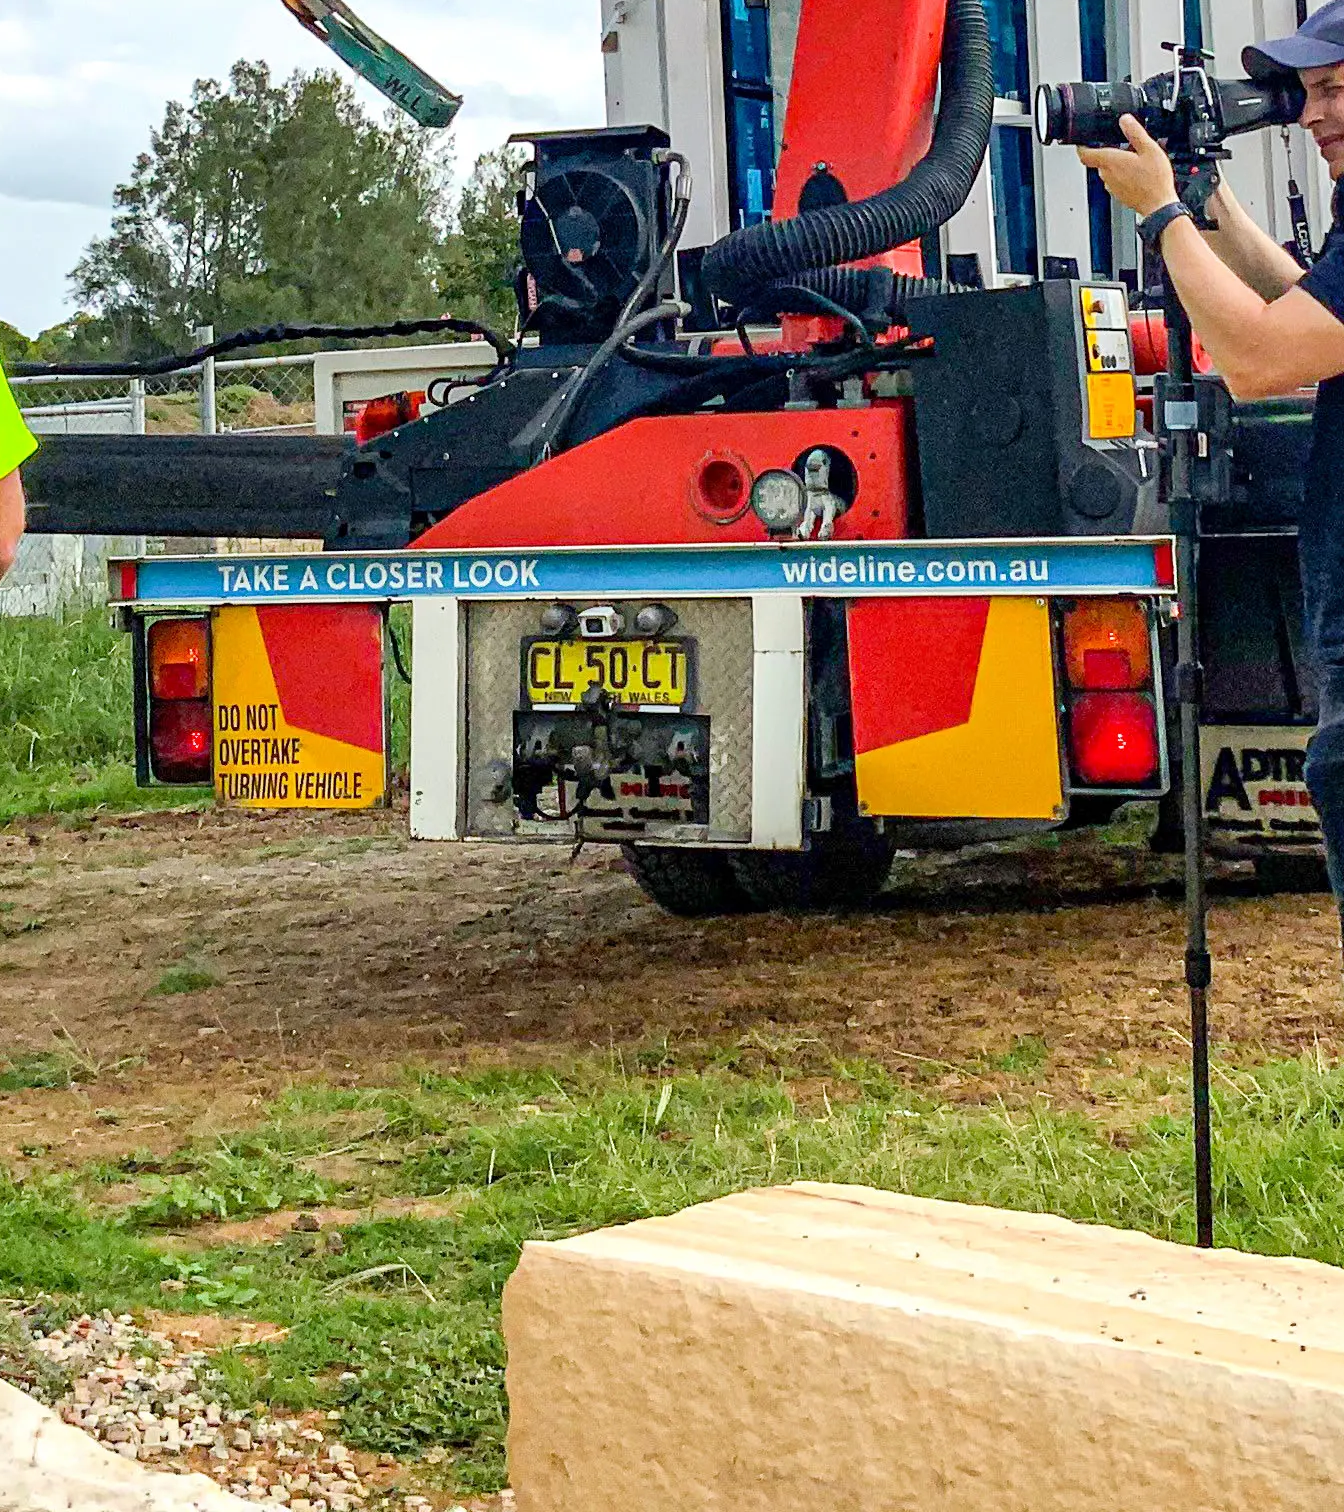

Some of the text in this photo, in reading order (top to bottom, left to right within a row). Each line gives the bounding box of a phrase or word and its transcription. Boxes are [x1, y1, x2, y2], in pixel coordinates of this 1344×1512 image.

[218, 559, 540, 592] TAKE A CLOSER LOOK
[782, 555, 1048, 583] wideline.com.au
[545, 692, 572, 702] NEW
[629, 692, 670, 702] WALES
[218, 704, 278, 731] DO NOT
[219, 738, 300, 766] OVERTAKE
[218, 771, 362, 800] TURNING VEHICLE
